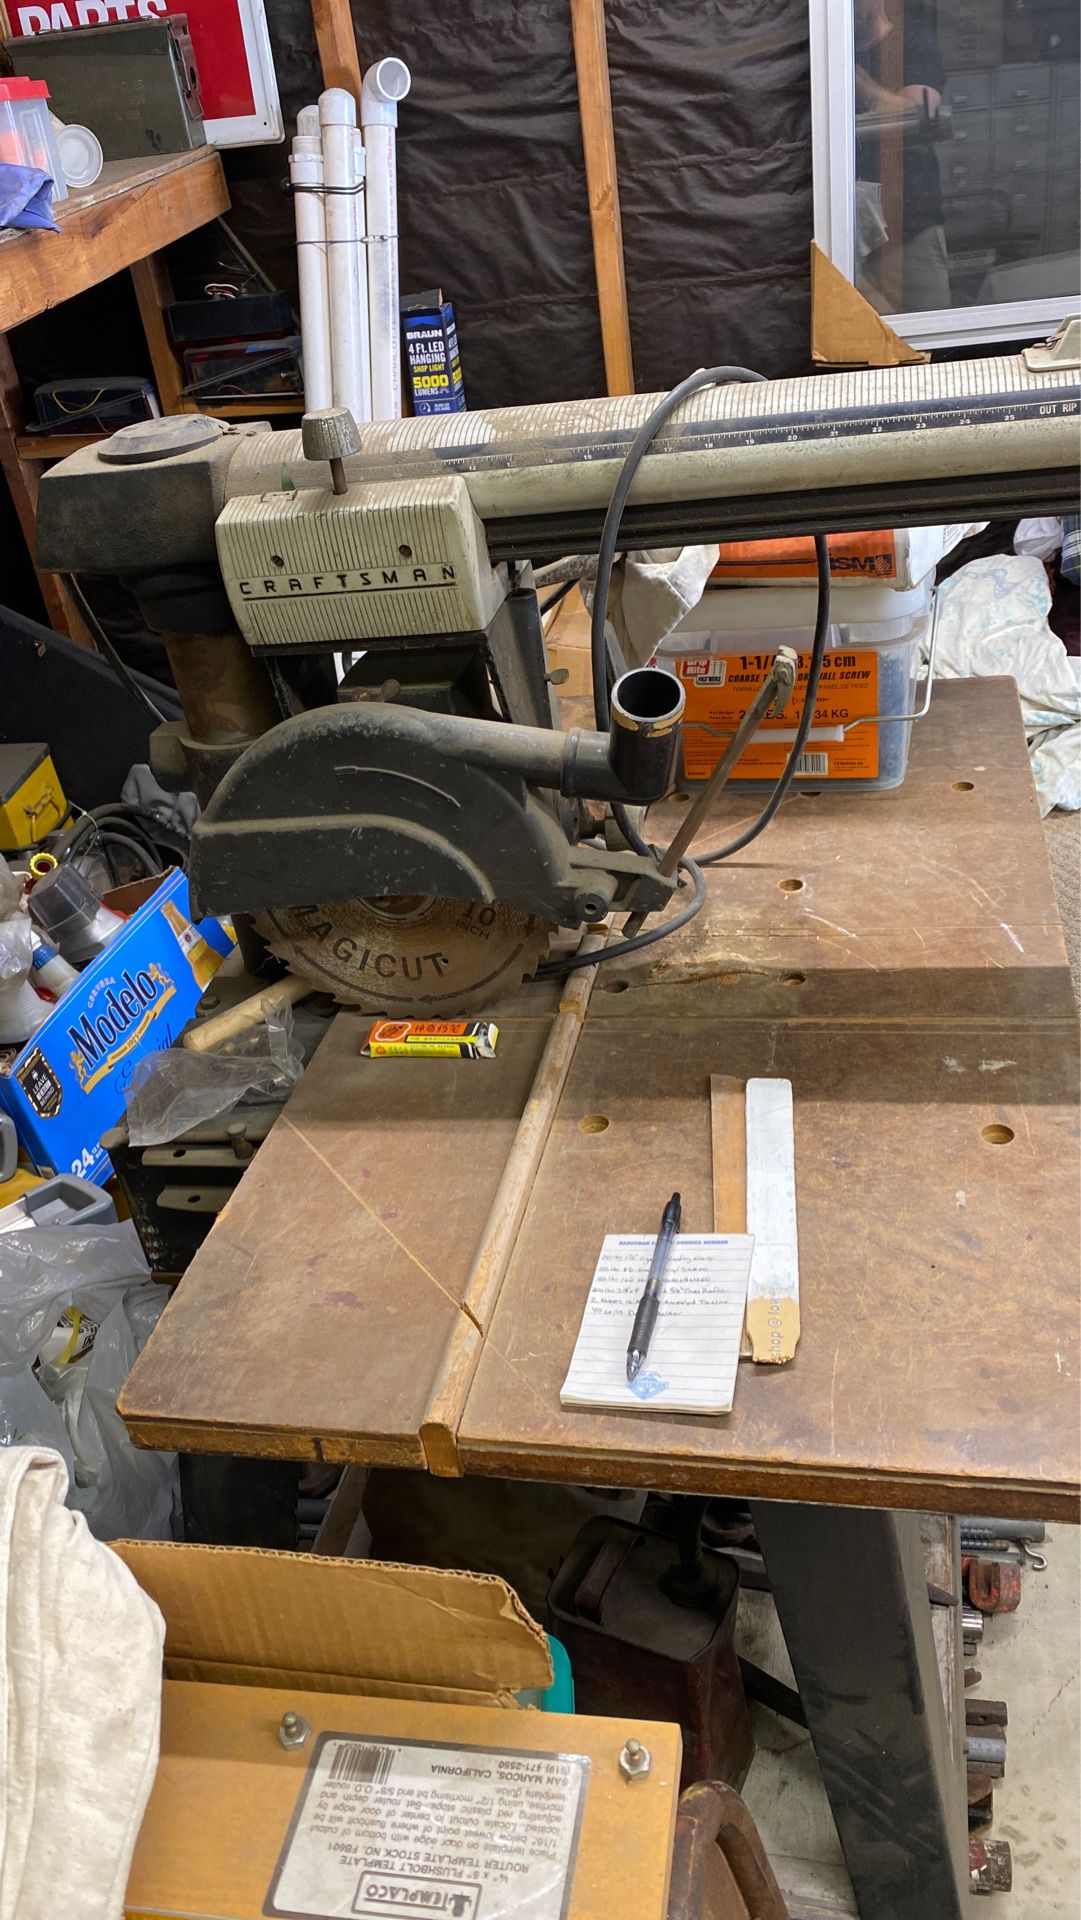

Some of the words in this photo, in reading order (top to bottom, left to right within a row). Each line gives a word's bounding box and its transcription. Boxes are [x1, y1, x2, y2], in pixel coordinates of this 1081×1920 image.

[18, 0, 167, 36] PARTS
[406, 329, 443, 340] BRAUN
[408, 344, 414, 354] 4
[428, 341, 444, 353] LED
[410, 353, 446, 365] HANGING
[413, 365, 428, 373] SHOP
[429, 364, 445, 372] LIGHT
[412, 374, 450, 388] 5000
[414, 388, 439, 396] LUMENS
[1039, 404, 1057, 415] OUT
[1062, 402, 1078, 414] RIP
[239, 565, 457, 594] CRAFTSMAN
[834, 656, 856, 668] cm
[728, 674, 761, 683] COARSE
[838, 670, 871, 680] SCREW
[831, 708, 849, 718] KG
[67, 968, 158, 1071] Modelo
[32, 1073, 48, 1094] LEAVE
[40, 1086, 55, 1108] BEHIND
[71, 1147, 96, 1178] 24
[768, 1318, 782, 1328] @
[768, 1331, 784, 1358] shop
[431, 1764, 492, 1779] CALIFORNIA
[496, 1770, 543, 1785] MARCOS,
[546, 1776, 568, 1786] SAN
[322, 1781, 350, 1790] router
[320, 1791, 338, 1799] and
[342, 1792, 368, 1803] depth
[397, 1788, 415, 1796] and
[416, 1790, 428, 1799] bit
[430, 1790, 473, 1803] mortising
[316, 1801, 328, 1811] by
[372, 1797, 401, 1807] router
[405, 1800, 422, 1811] Set
[498, 1797, 524, 1808] using
[332, 1804, 356, 1813] edge
[359, 1807, 382, 1816] door
[386, 1810, 396, 1818] of
[460, 1806, 492, 1816] plastic
[497, 1809, 513, 1818] red
[313, 1813, 324, 1822] be
[401, 1811, 430, 1822] center
[448, 1816, 479, 1826] cutout
[518, 1810, 562, 1824] adjusting
[347, 1818, 387, 1829] flushbolt
[390, 1822, 418, 1832] where
[484, 1820, 516, 1832] Locate
[308, 1825, 338, 1835] cutout
[341, 1828, 350, 1836] of
[354, 1830, 387, 1840] bottom
[422, 1826, 432, 1834] of
[437, 1826, 461, 1836] point
[464, 1830, 494, 1841] lowest
[390, 1834, 409, 1842] with
[414, 1834, 438, 1846] edge
[497, 1834, 527, 1844] below
[442, 1840, 463, 1849] door
[483, 1844, 524, 1856] template
[362, 1846, 381, 1856] NO.
[384, 1848, 420, 1860] STOCK
[529, 1849, 556, 1860] Place
[339, 1856, 394, 1870] TEMPLATE
[422, 1852, 480, 1868] TEMPLATE
[398, 1862, 463, 1878] FLUSHBOLT
[484, 1859, 529, 1873] ROUTER
